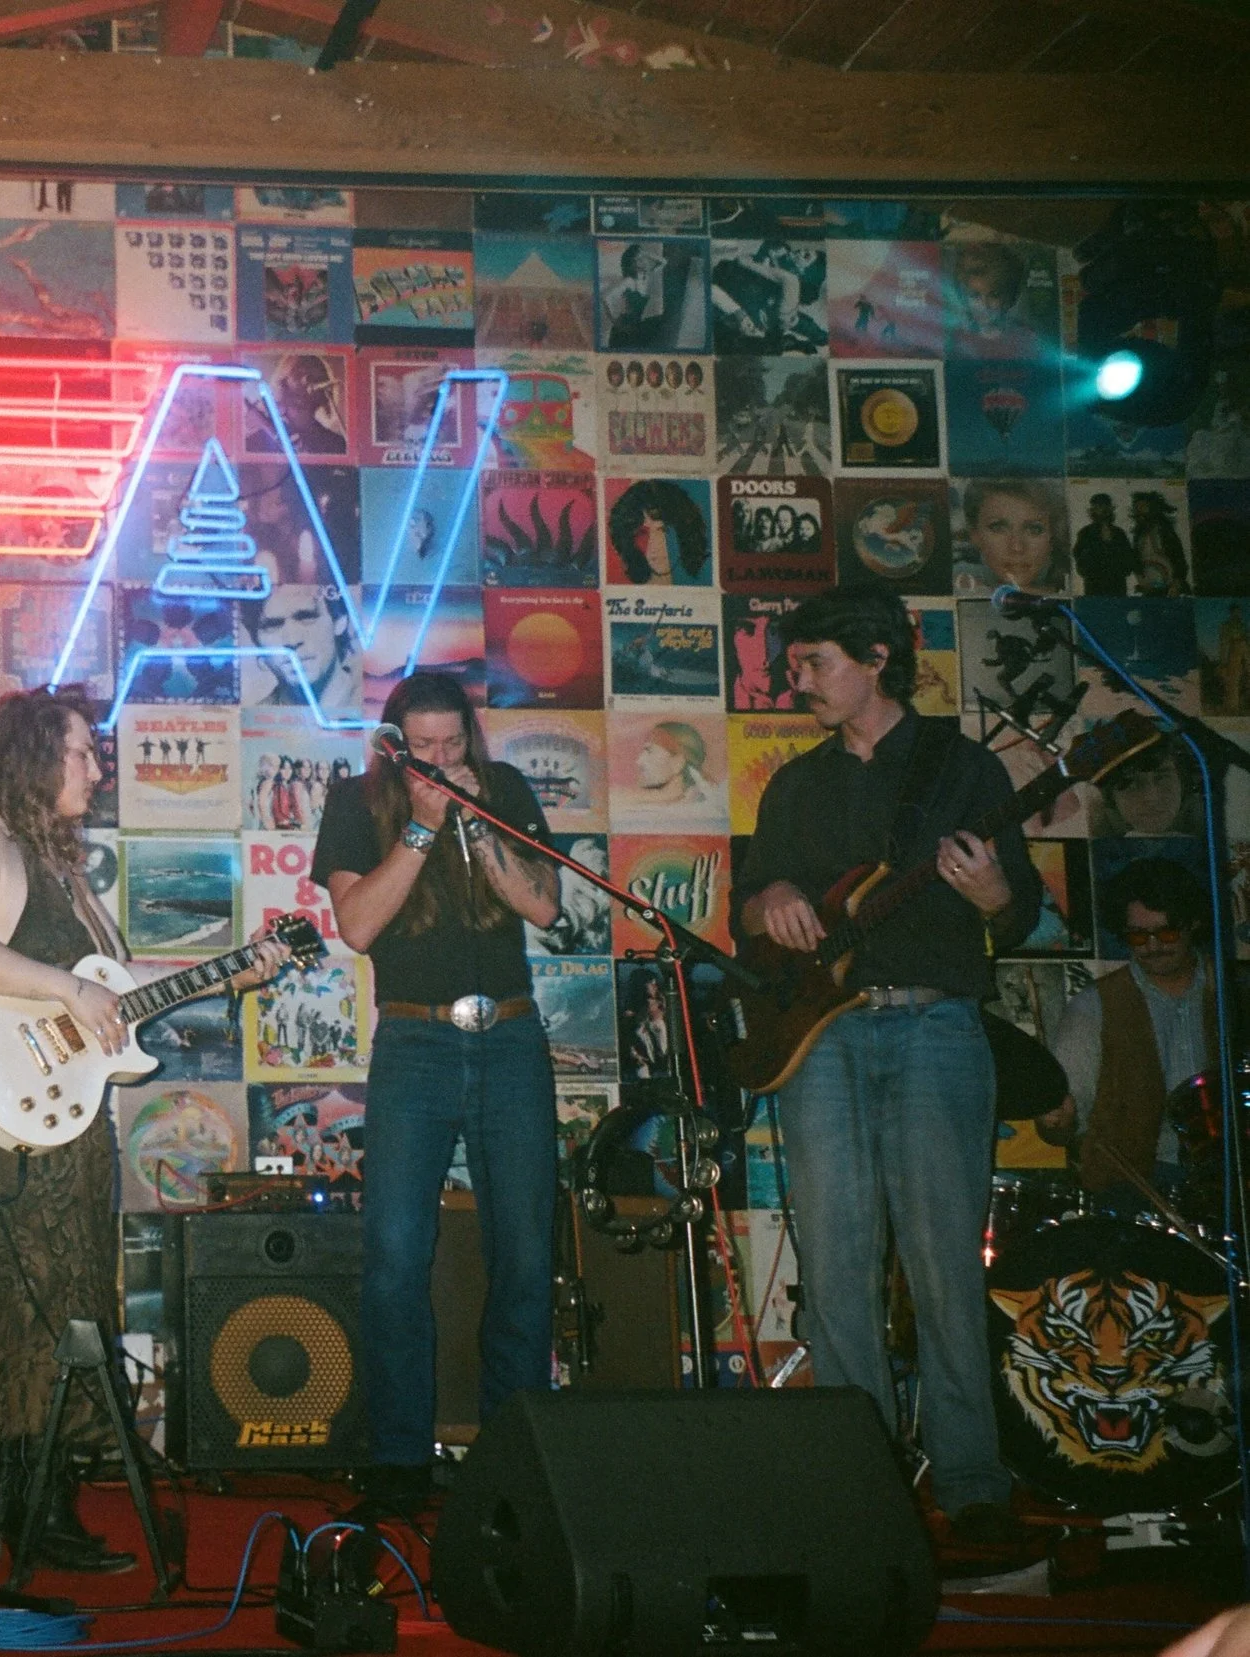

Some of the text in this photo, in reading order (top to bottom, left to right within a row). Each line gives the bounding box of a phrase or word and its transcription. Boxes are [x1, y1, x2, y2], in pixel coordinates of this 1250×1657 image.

[730, 479, 797, 496] DOORS
[605, 596, 630, 616] The
[633, 598, 694, 626] Surfaris
[134, 719, 228, 734] BEATLES
[250, 844, 315, 876] RO
[293, 875, 323, 907] &
[625, 849, 720, 924] Stuff
[560, 961, 608, 977] DRAG
